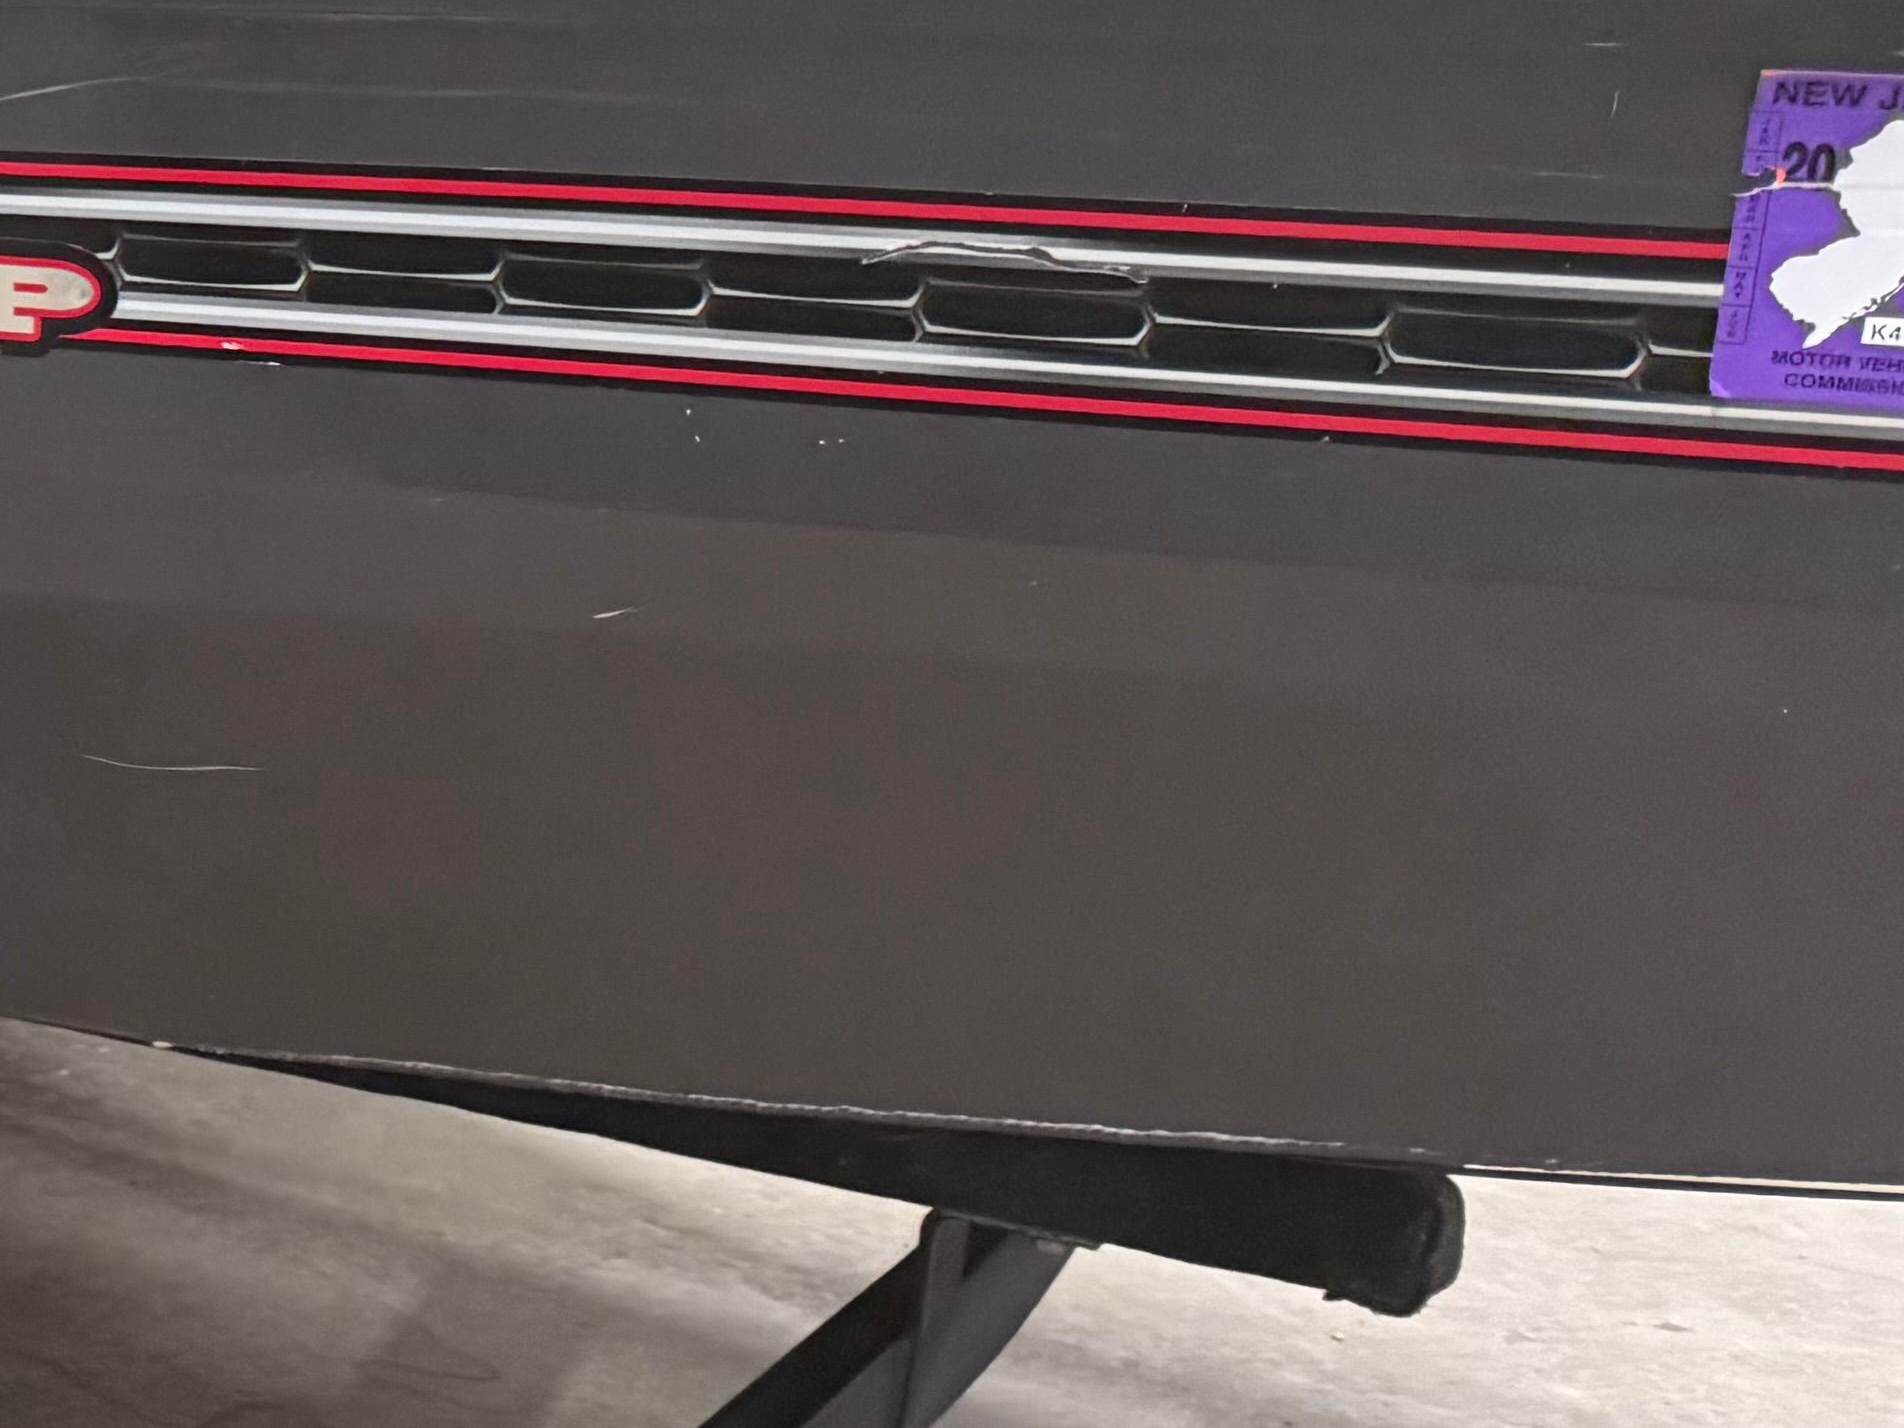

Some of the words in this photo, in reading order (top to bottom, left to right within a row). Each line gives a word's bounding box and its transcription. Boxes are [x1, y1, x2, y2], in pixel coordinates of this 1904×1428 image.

[1771, 81, 1868, 108] NEW
[1771, 350, 1852, 370] MOTOR
[1859, 357, 1904, 372] VEH
